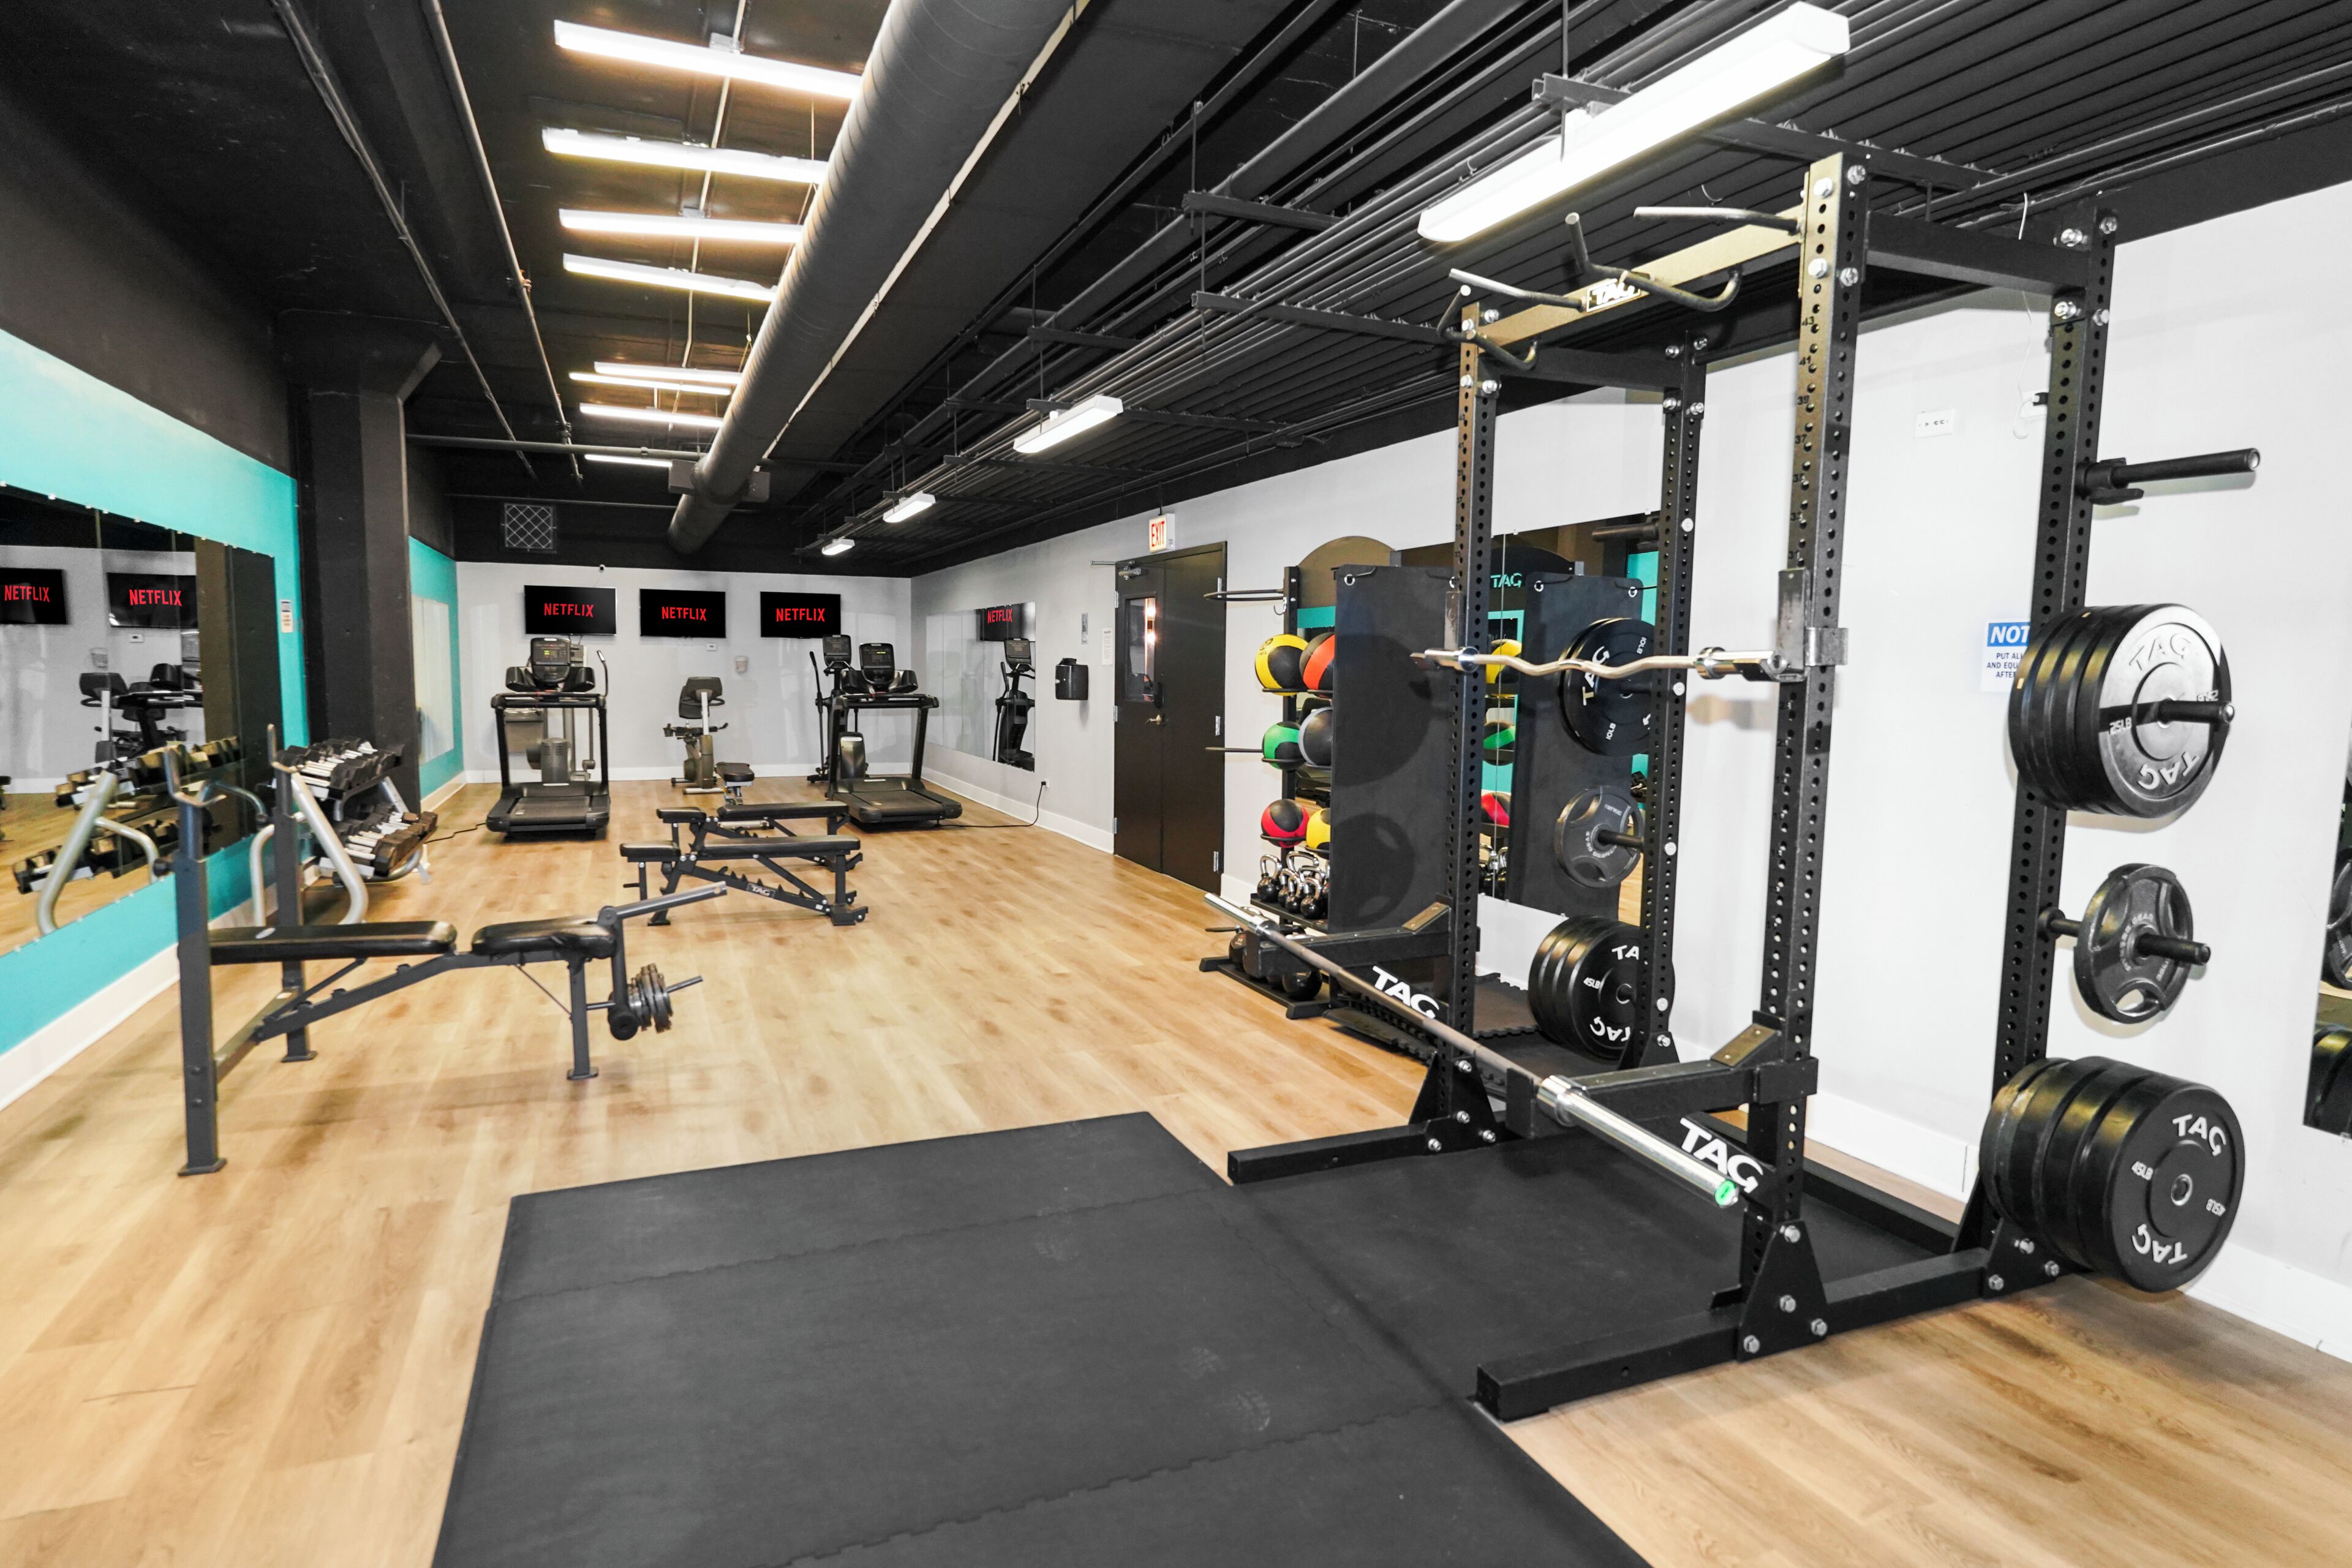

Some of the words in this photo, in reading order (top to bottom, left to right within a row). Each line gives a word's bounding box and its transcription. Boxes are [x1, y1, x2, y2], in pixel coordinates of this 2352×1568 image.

[1801, 316, 1814, 327] 43
[1799, 356, 1811, 366] 41
[1152, 521, 1165, 547] EXIT
[5, 586, 50, 603] NETFLIX
[129, 589, 182, 606] NETFLIX
[544, 603, 594, 617] NETFLIX
[662, 606, 707, 621] NETFLIX
[776, 608, 825, 622] NETFLIX
[987, 609, 1012, 624] NETFLIX
[1990, 625, 2030, 643] NOT
[2109, 717, 2132, 734] 25LB
[1611, 944, 1640, 960] TA
[1583, 977, 1601, 990] 45LB
[2131, 1161, 2154, 1180] 45LB
